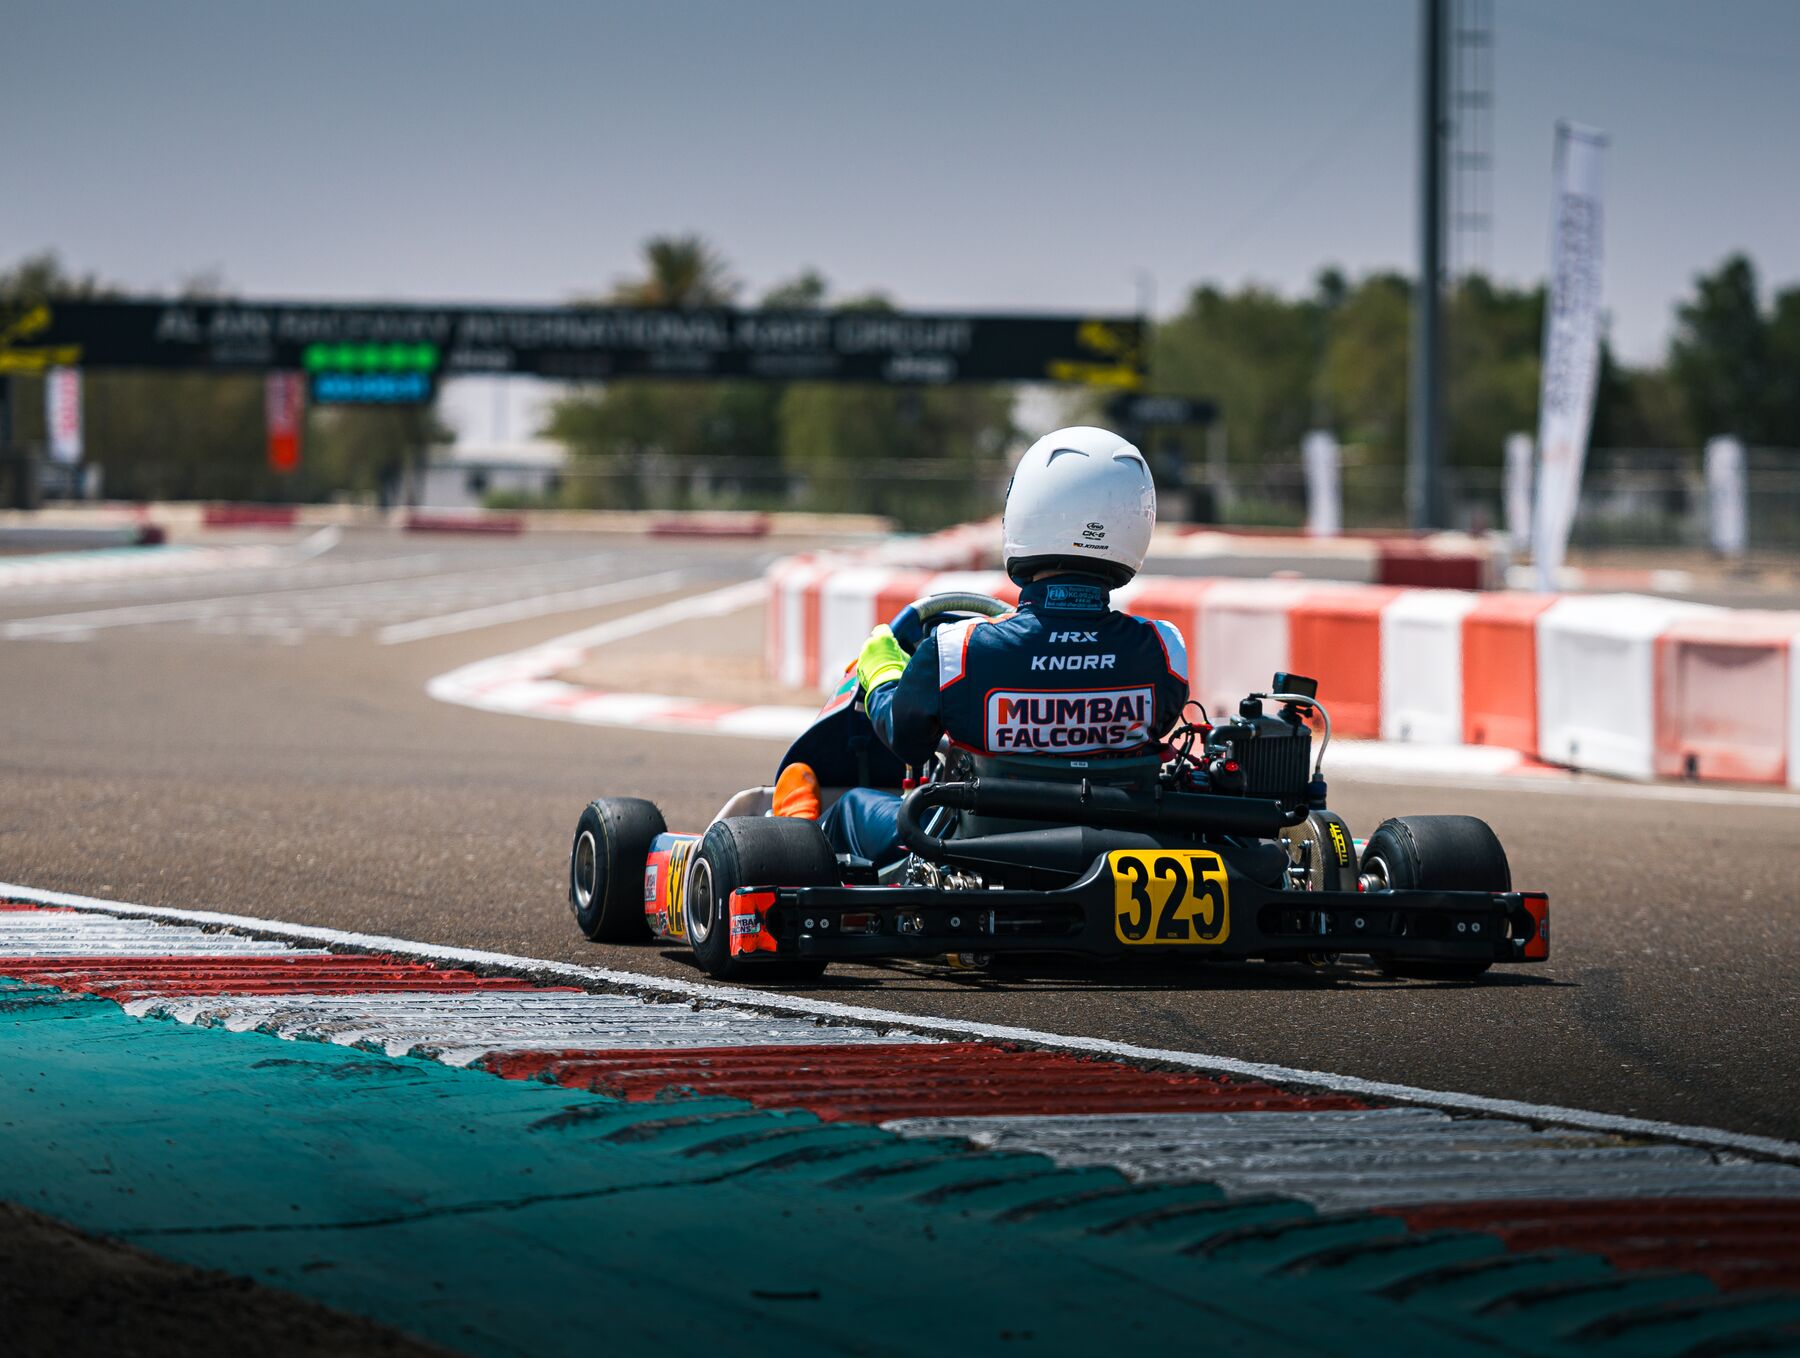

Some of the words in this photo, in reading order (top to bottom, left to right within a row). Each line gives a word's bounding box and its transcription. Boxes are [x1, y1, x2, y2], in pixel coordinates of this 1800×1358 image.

[1082, 530, 1105, 538] CK-6
[1049, 589, 1066, 599] FIA
[1049, 631, 1099, 643] HRX
[1031, 654, 1116, 670] KNORR
[997, 694, 1145, 725] MUMBAI
[996, 725, 1125, 748] FALCONS
[1117, 856, 1224, 940] 325
